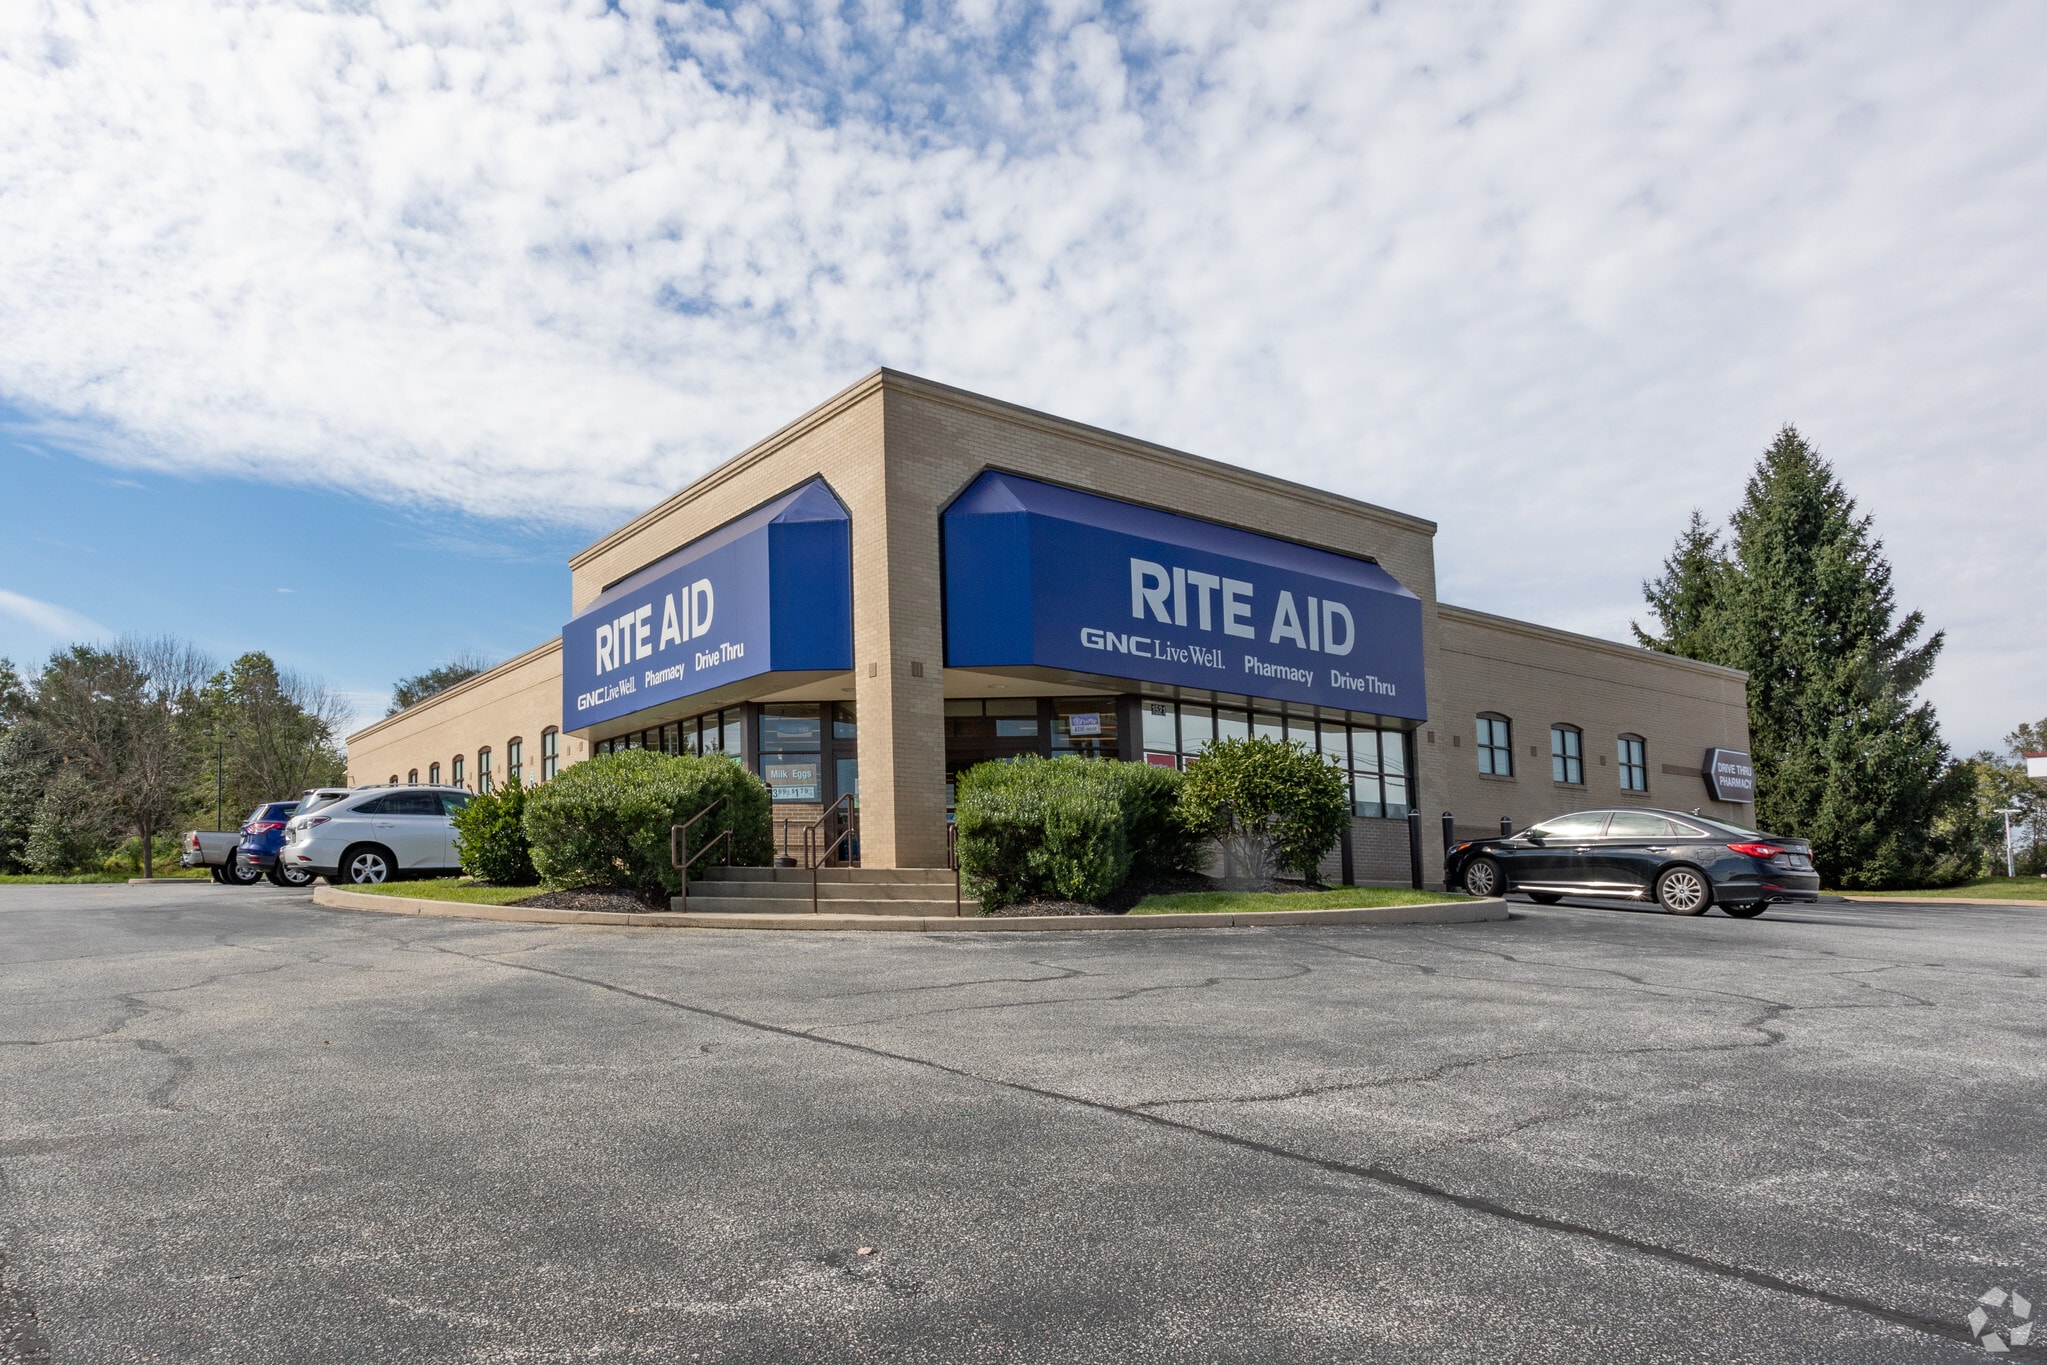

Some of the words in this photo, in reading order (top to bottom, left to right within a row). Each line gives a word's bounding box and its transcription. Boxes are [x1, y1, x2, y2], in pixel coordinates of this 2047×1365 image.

[596, 603, 652, 676] RITE
[659, 578, 714, 651] AID
[1130, 557, 1255, 639] RITE
[1269, 589, 1355, 656] AID
[577, 687, 604, 711] GNC
[604, 684, 620, 703] Live
[645, 663, 685, 688] Pharmacy
[695, 650, 720, 671] Drive
[720, 642, 744, 662] Thru
[1080, 627, 1152, 658] GNC
[1153, 640, 1189, 663] Live
[1244, 655, 1314, 687] Pharmacy
[1330, 669, 1365, 692] Drive
[1365, 675, 1396, 697] Thru
[771, 770, 788, 779] Milk
[792, 769, 812, 779] Eggs
[1717, 762, 1736, 774] DRIVE
[1736, 764, 1752, 776] THRU
[1719, 776, 1752, 789] PHARMACY
